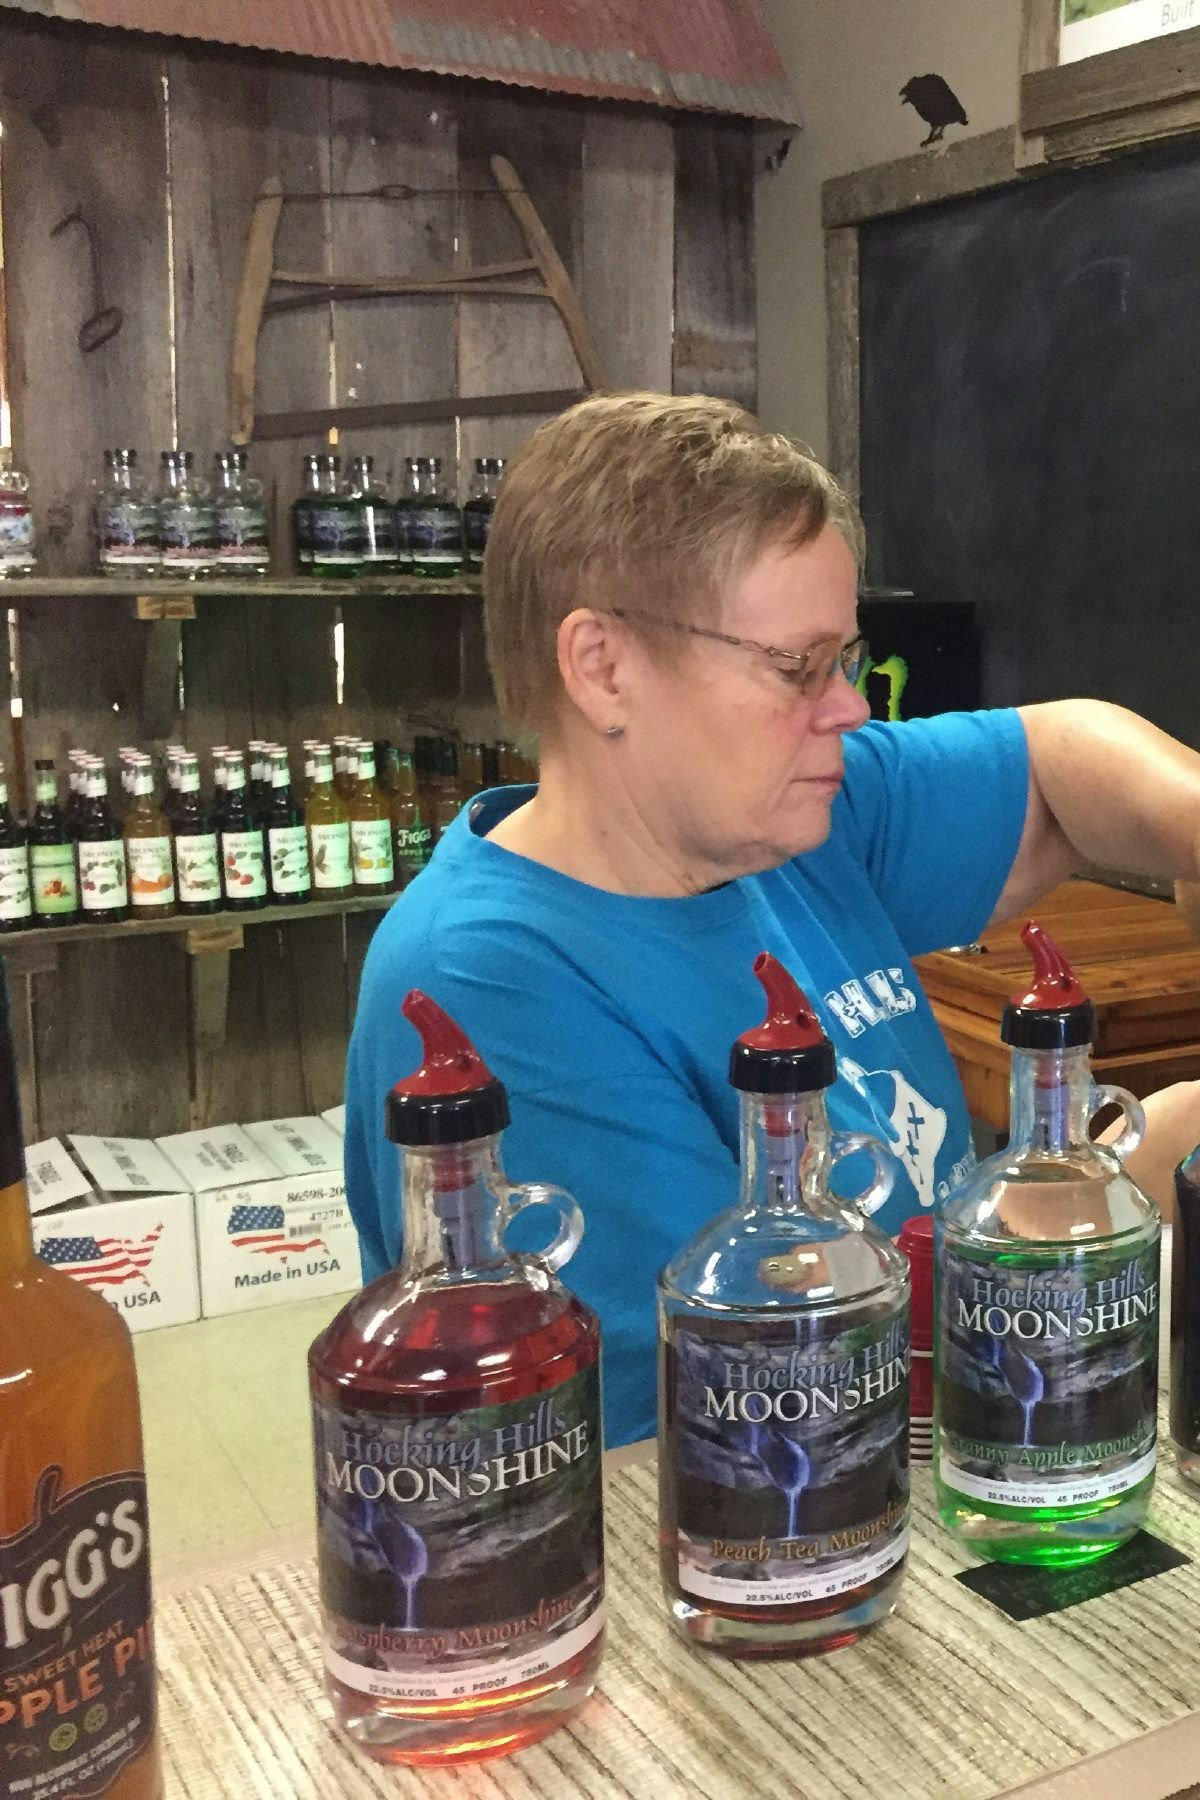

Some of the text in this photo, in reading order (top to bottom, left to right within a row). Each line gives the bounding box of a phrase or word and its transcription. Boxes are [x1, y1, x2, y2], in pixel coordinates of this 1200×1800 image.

[234, 1259, 341, 1289] Made in USA
[972, 1258, 1146, 1317] Hocking Hills
[124, 1290, 161, 1308] USA
[957, 1282, 1157, 1339] MOONSHINE
[703, 1345, 910, 1423] MOONSHIN
[723, 1350, 855, 1391] Hocking
[340, 1397, 566, 1472] Hocking Hills
[326, 1420, 590, 1502] MOONSHINE
[1018, 1441, 1075, 1472] Apple
[1072, 1490, 1099, 1502] PROOF
[712, 1536, 772, 1562] Peach
[780, 1541, 819, 1560] Tea
[841, 1572, 869, 1589] PROOF
[4, 1620, 123, 1693] SWEET HEAT
[452, 1686, 465, 1695] 45
[472, 1676, 507, 1692] PROOF
